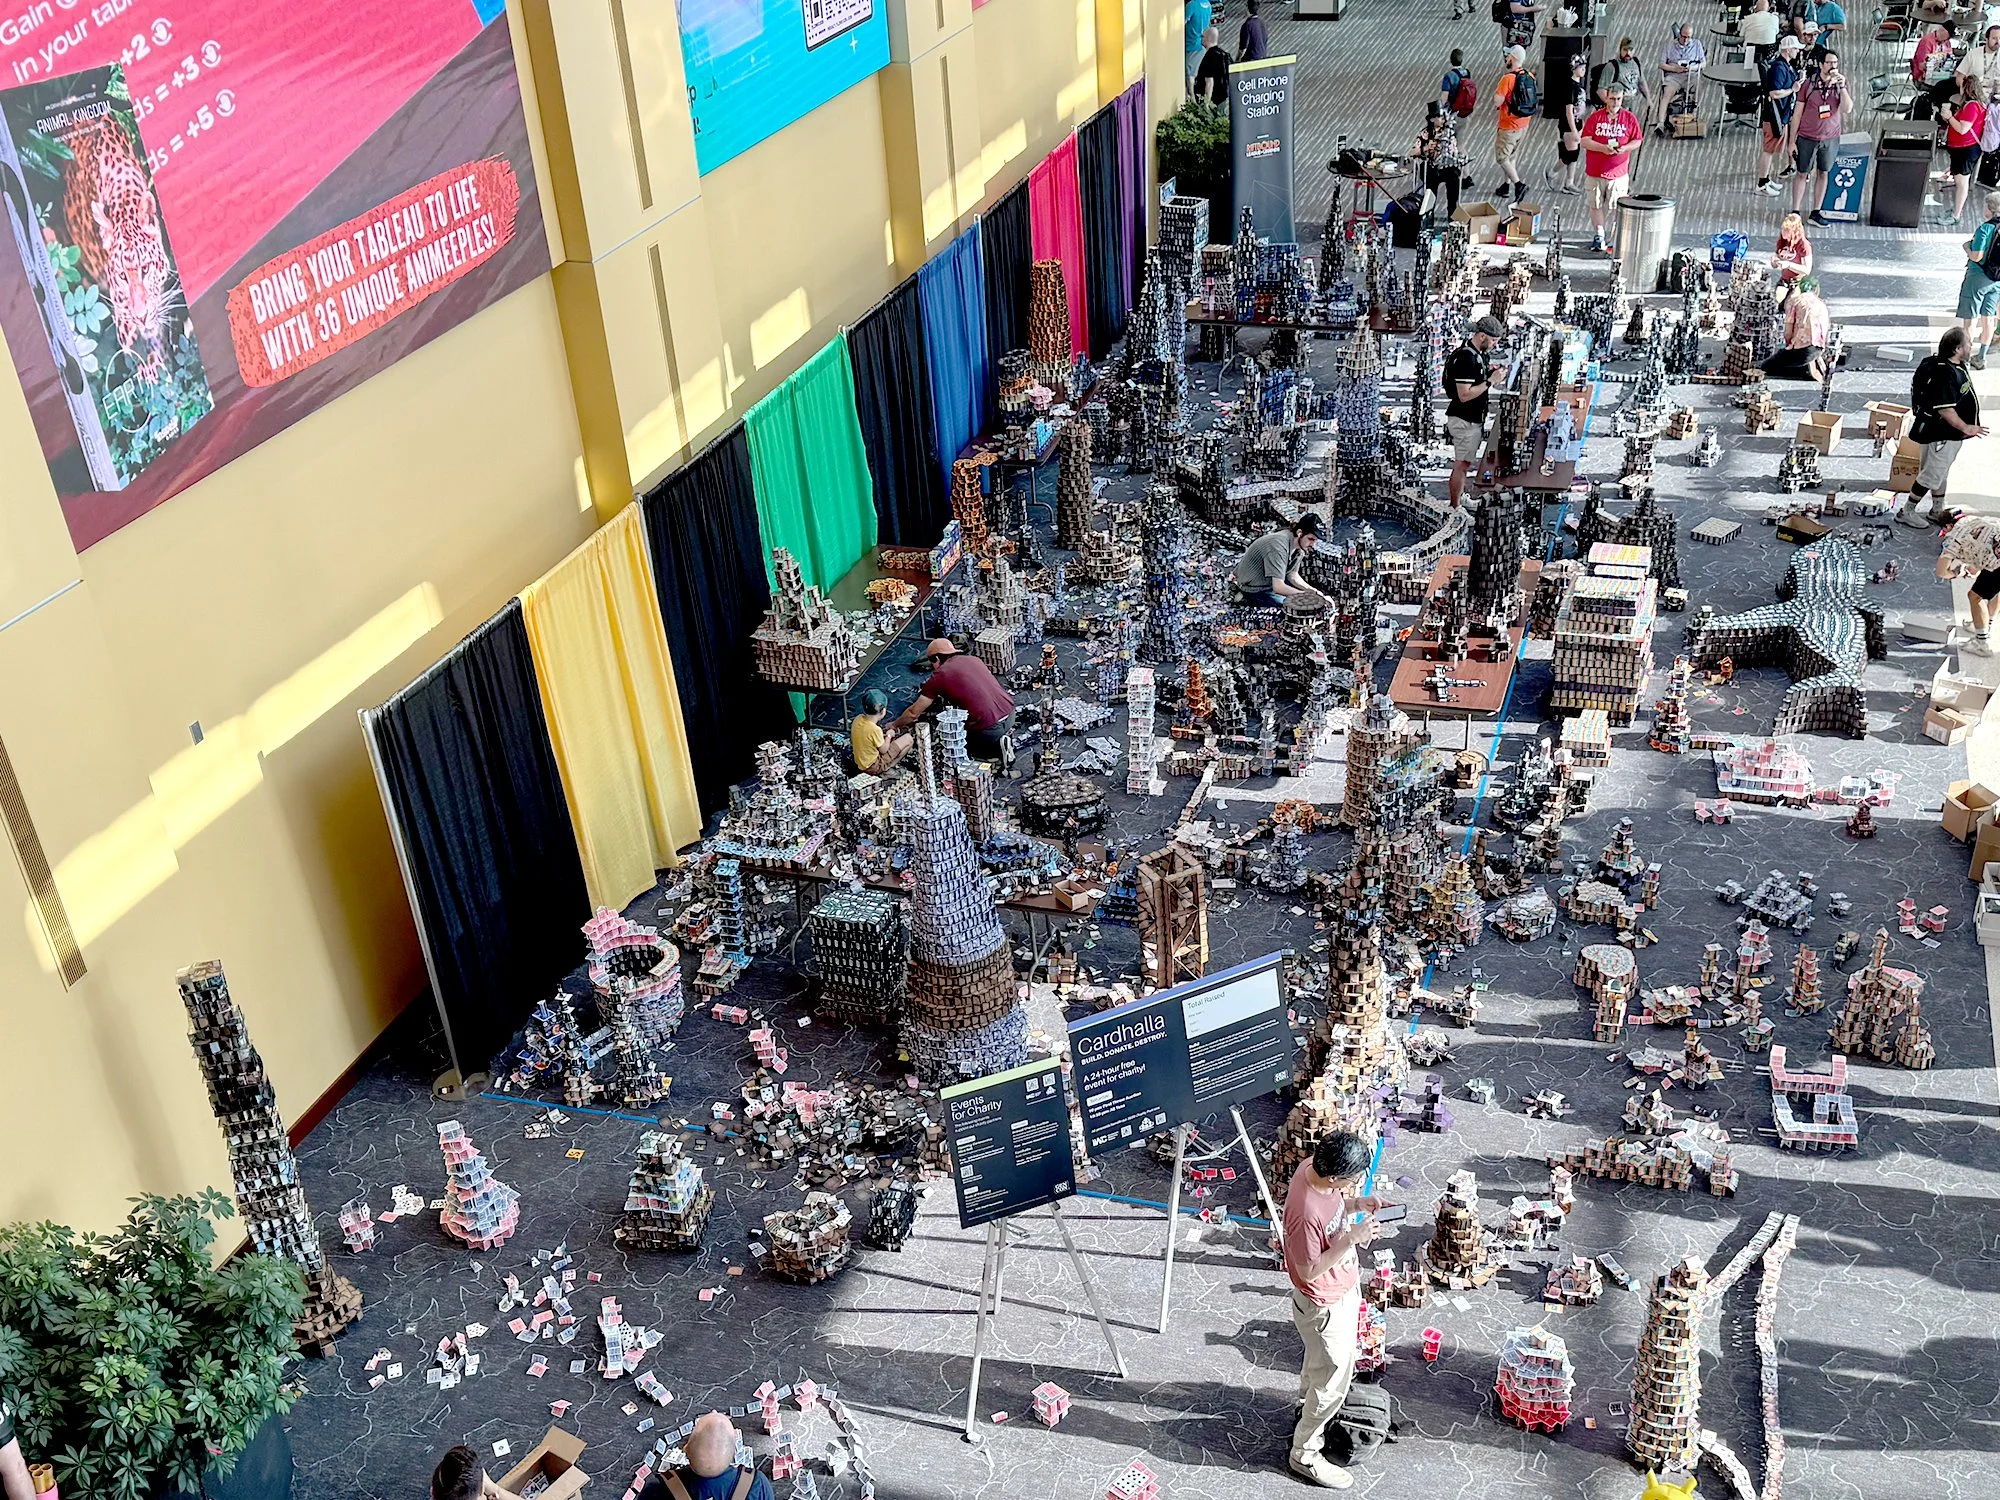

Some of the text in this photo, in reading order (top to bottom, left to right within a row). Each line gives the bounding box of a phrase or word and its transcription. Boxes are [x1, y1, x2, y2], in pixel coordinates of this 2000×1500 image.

[0, 1, 53, 45] Gain
[12, 0, 133, 84] in your tab
[120, 33, 151, 66] +2
[133, 95, 154, 123] ds
[171, 54, 200, 88] +3
[1238, 75, 1289, 92] Cell Phone
[1241, 89, 1285, 105] Charging
[37, 112, 72, 134] ANIMAL
[72, 100, 111, 123] KINGDOM
[1246, 105, 1280, 119] Station
[147, 147, 169, 176] ds
[186, 104, 215, 138] +5
[249, 174, 481, 325] BRING YOUR TABLEAU TO LIFE
[260, 212, 498, 370] WITH 36 UNIQUE ANIMEEPLES!
[1187, 990, 1225, 1009] Total Raised
[1078, 1014, 1165, 1055] Cardhalla
[1081, 1031, 1168, 1065] BUILD. DONATE. DESTROY.
[1083, 1060, 1136, 1083] A 24-hour free
[1084, 1063, 1147, 1091] event for charity!
[950, 1095, 985, 1112] Events
[951, 1100, 1003, 1121] for Charity
